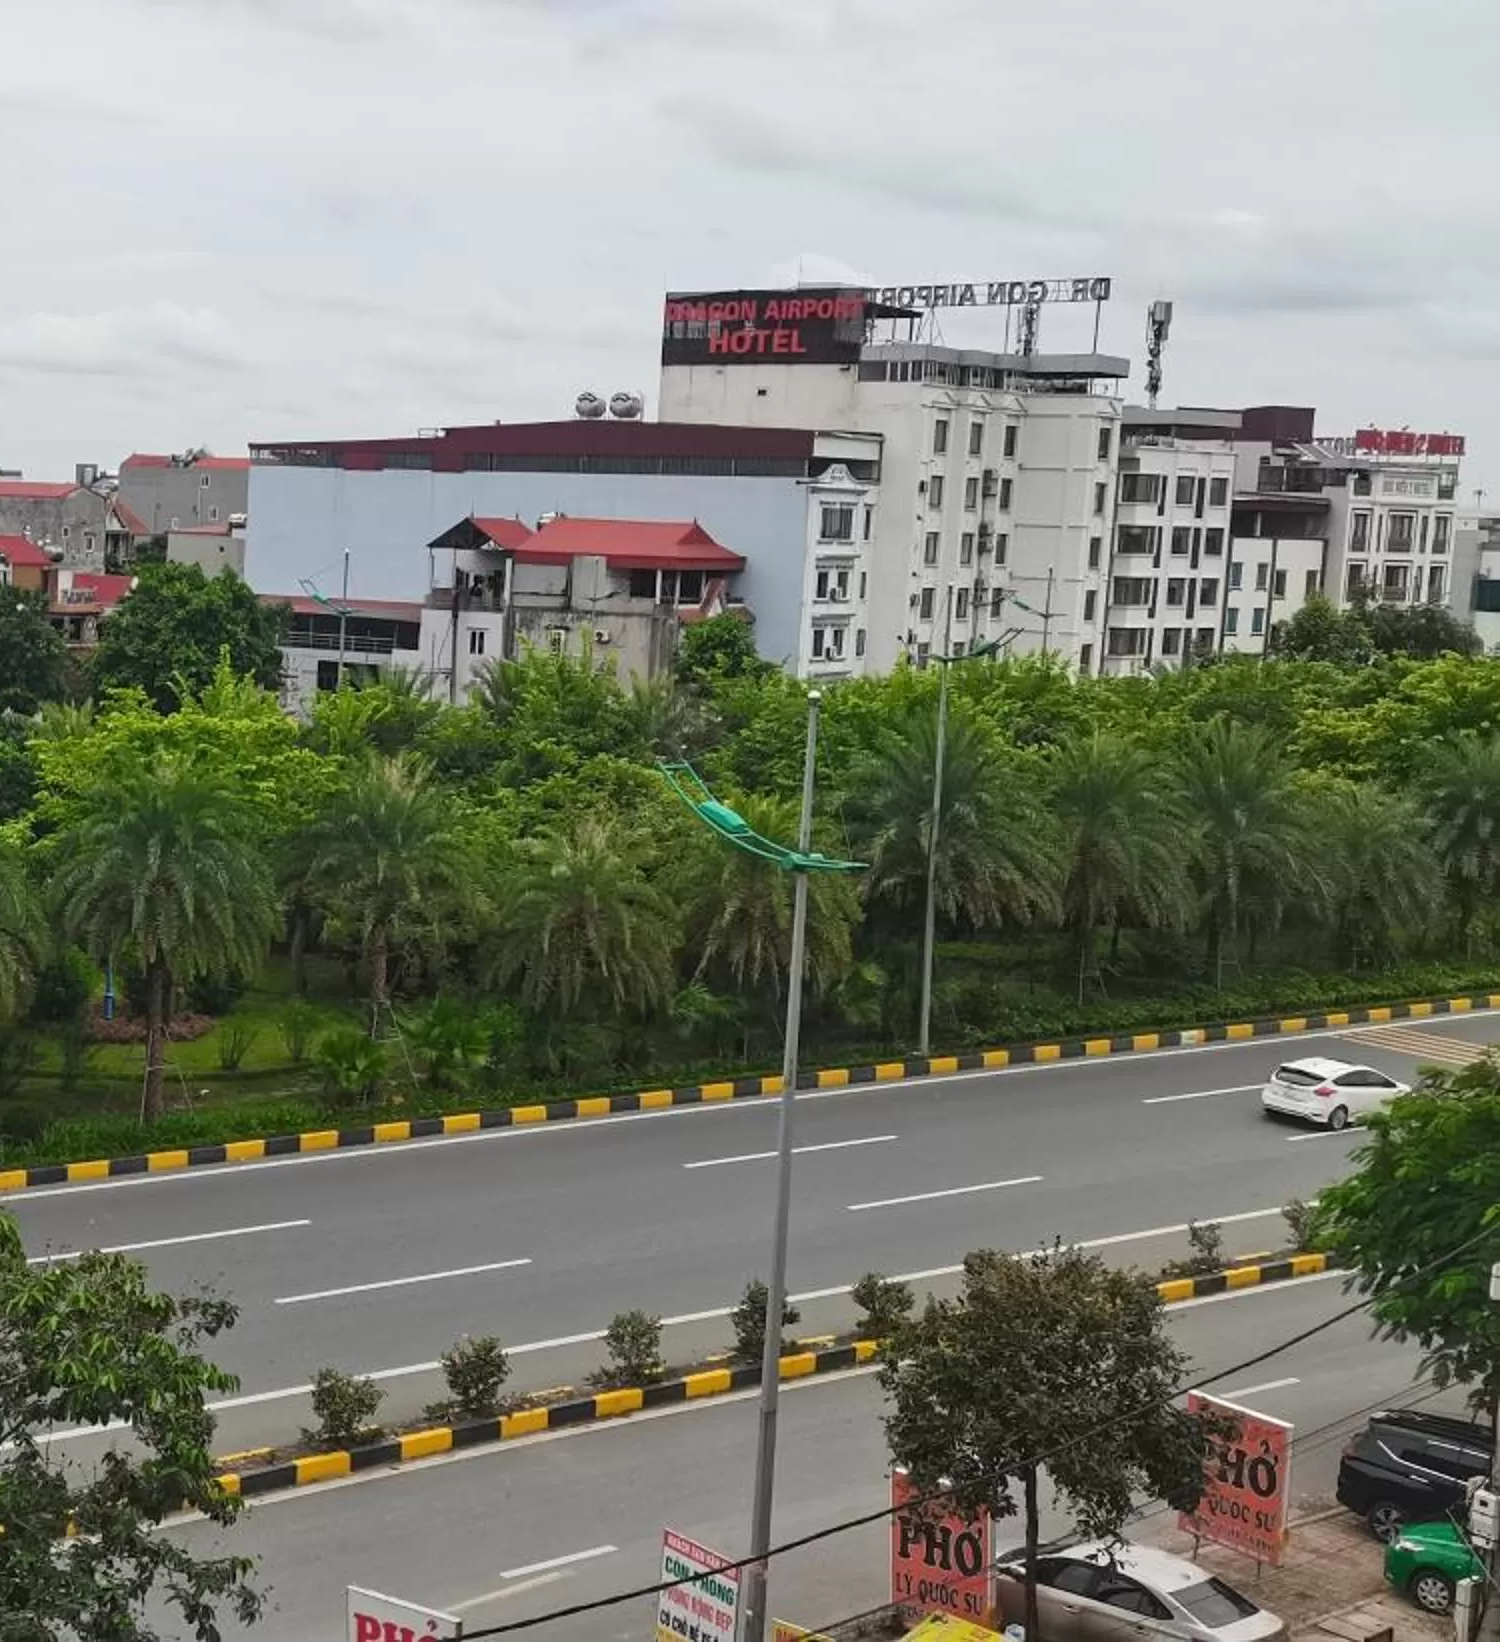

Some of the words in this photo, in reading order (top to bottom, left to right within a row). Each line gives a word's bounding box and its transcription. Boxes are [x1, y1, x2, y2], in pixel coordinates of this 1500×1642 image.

[666, 299, 757, 321] DRAGON
[764, 295, 867, 320] AIRPORT
[709, 328, 807, 354] HOTEL
